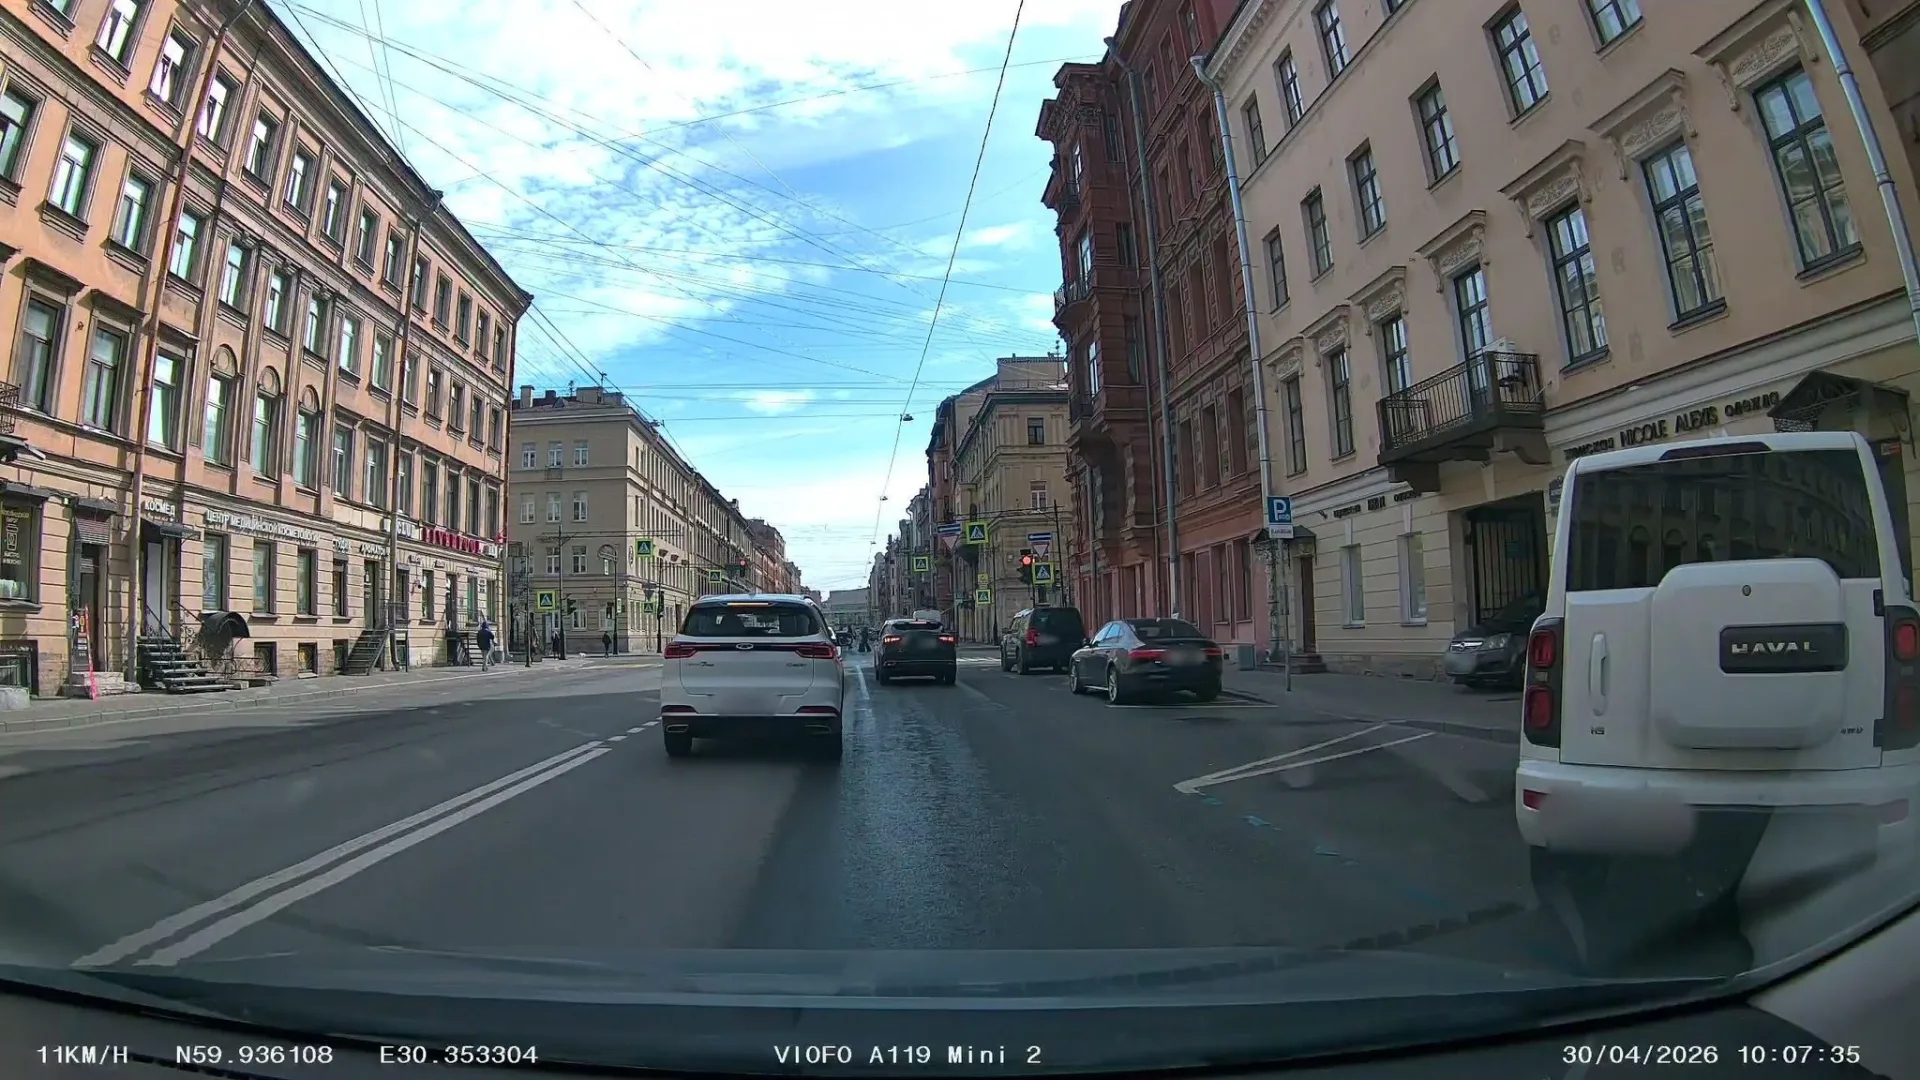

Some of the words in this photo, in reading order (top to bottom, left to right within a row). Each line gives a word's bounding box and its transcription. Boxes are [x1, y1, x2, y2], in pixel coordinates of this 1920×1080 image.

[1620, 419, 1669, 447] NICOLE
[1675, 405, 1718, 433] ALEXIS
[144, 499, 176, 517] КОСМЕД
[206, 509, 229, 525] ЦЕНТР
[230, 514, 278, 533] МЕДИЦИНСКОЙ
[1731, 641, 1819, 654] HAVAL
